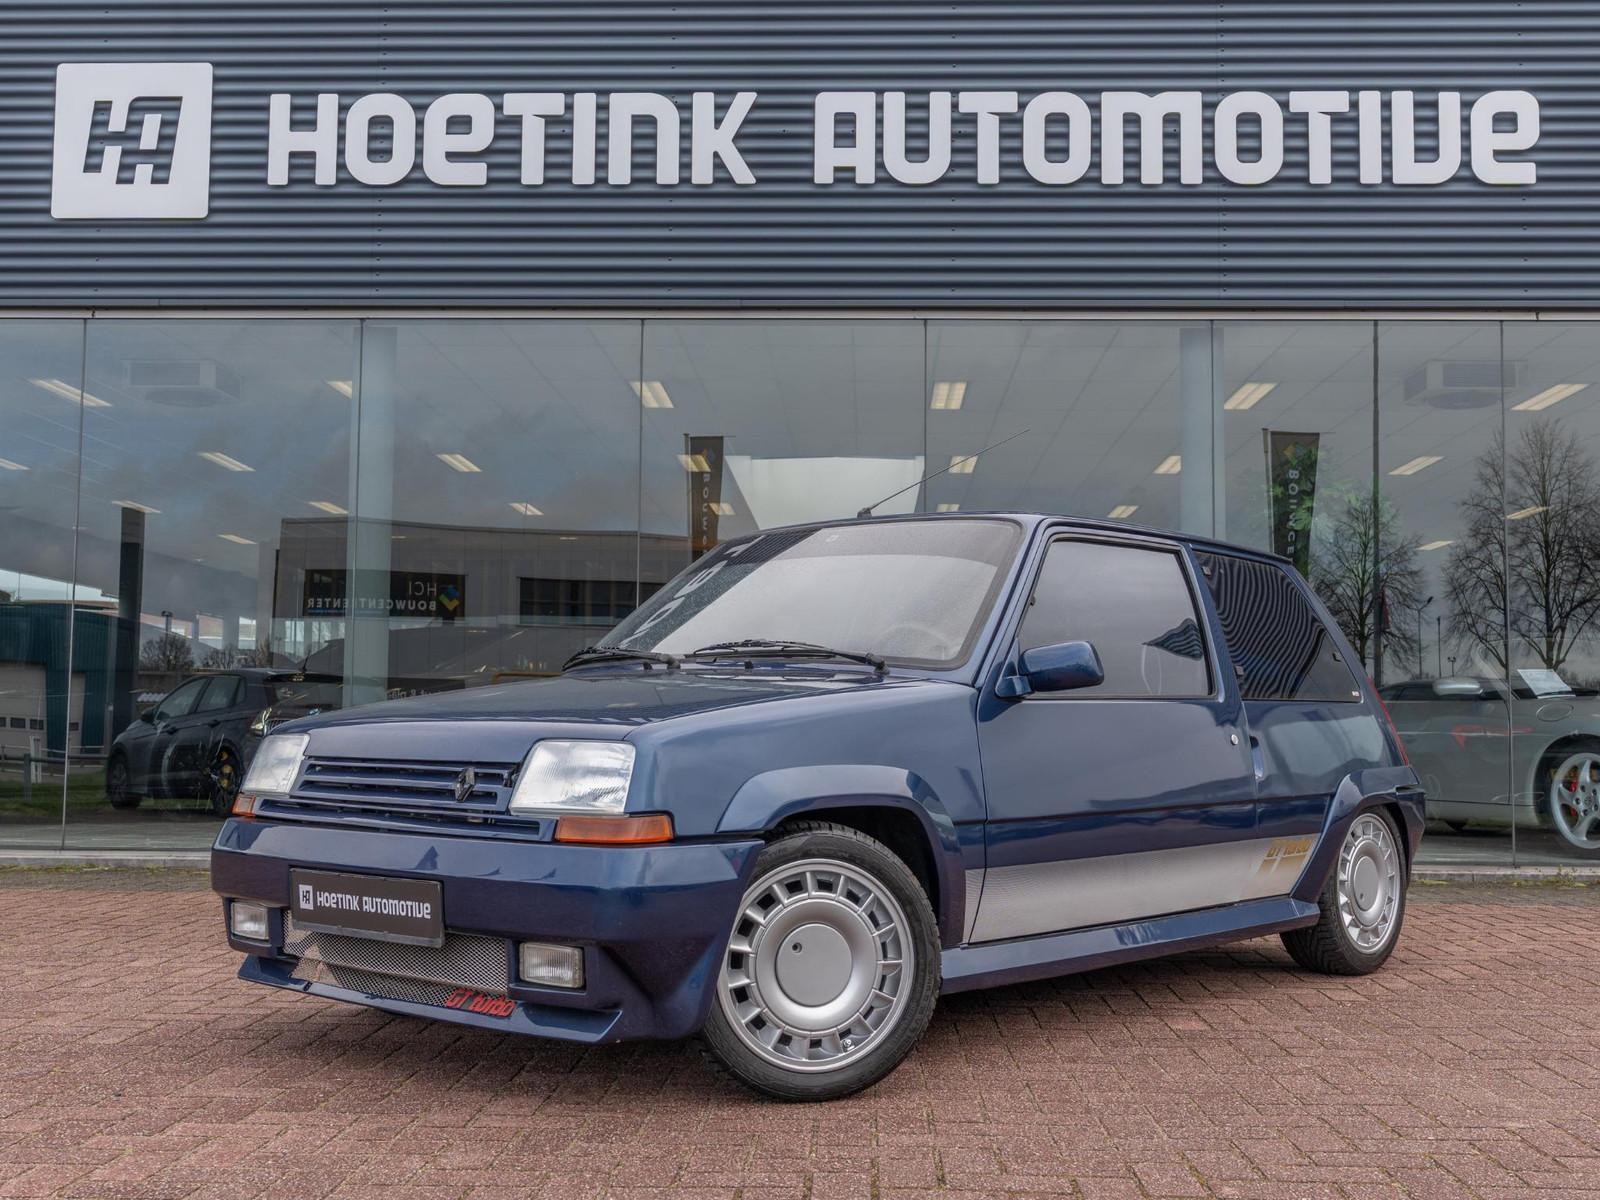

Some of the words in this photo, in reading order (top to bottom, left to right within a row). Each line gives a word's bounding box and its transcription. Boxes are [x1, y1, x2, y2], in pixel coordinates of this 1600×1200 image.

[267, 91, 758, 187] HOETINK
[814, 90, 1541, 186] AUTOMOTIVE
[316, 891, 361, 912] HOETINK
[362, 896, 432, 920] AUTOMOTIVE
